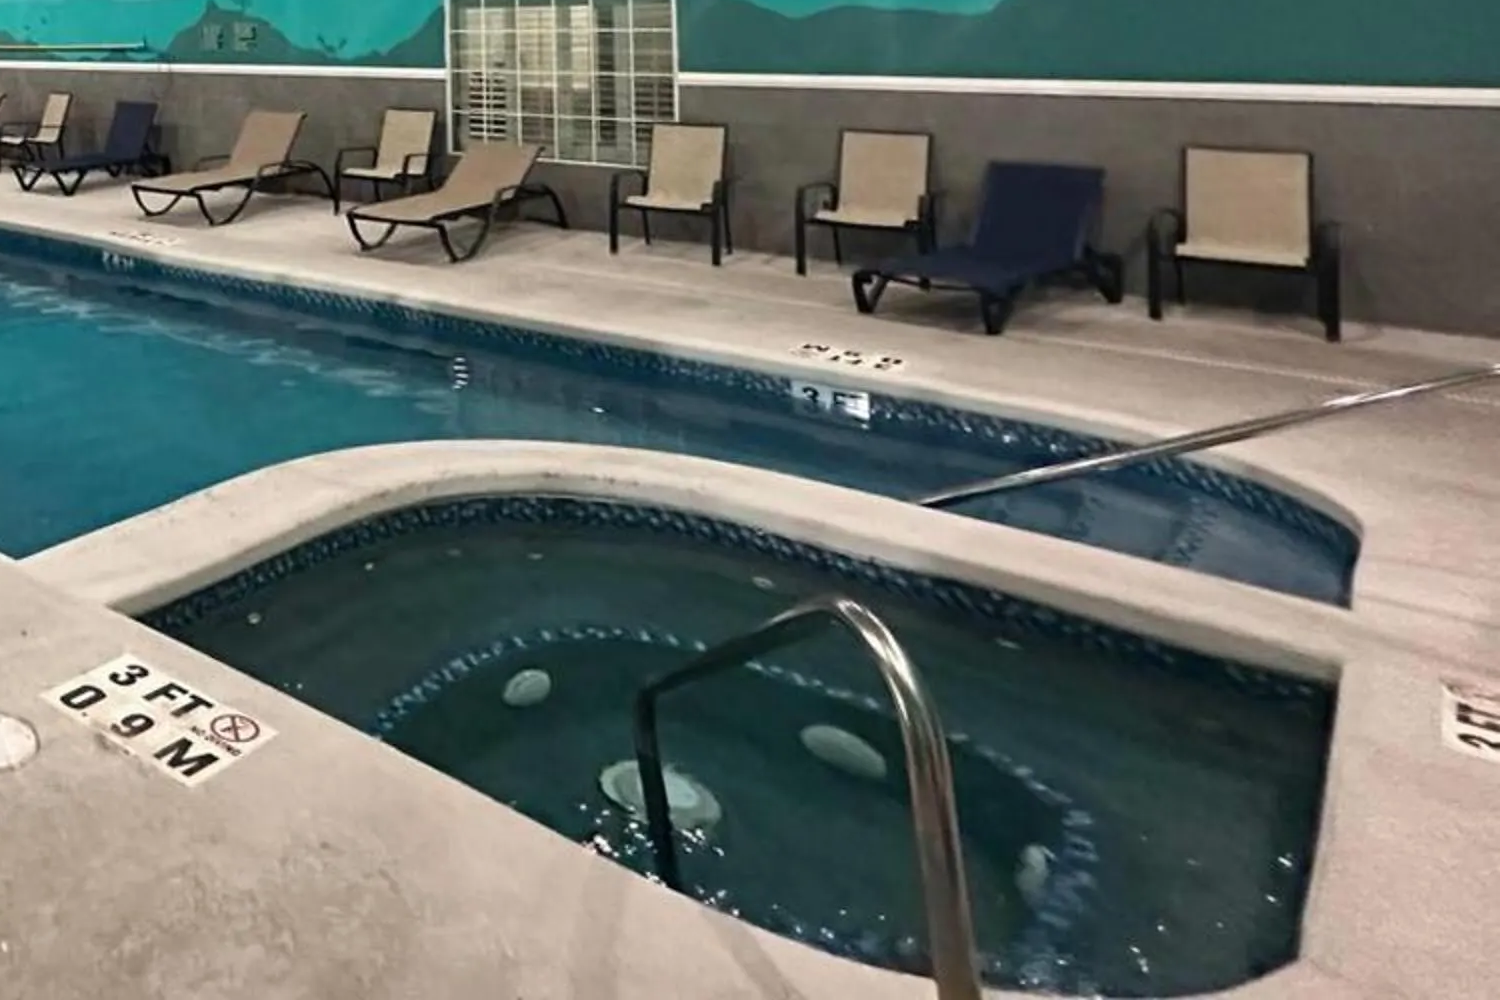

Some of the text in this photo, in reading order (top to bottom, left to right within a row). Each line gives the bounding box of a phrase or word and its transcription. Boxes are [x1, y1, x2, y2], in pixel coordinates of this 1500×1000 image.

[108, 664, 215, 718] 3 FT
[153, 737, 220, 778] M
